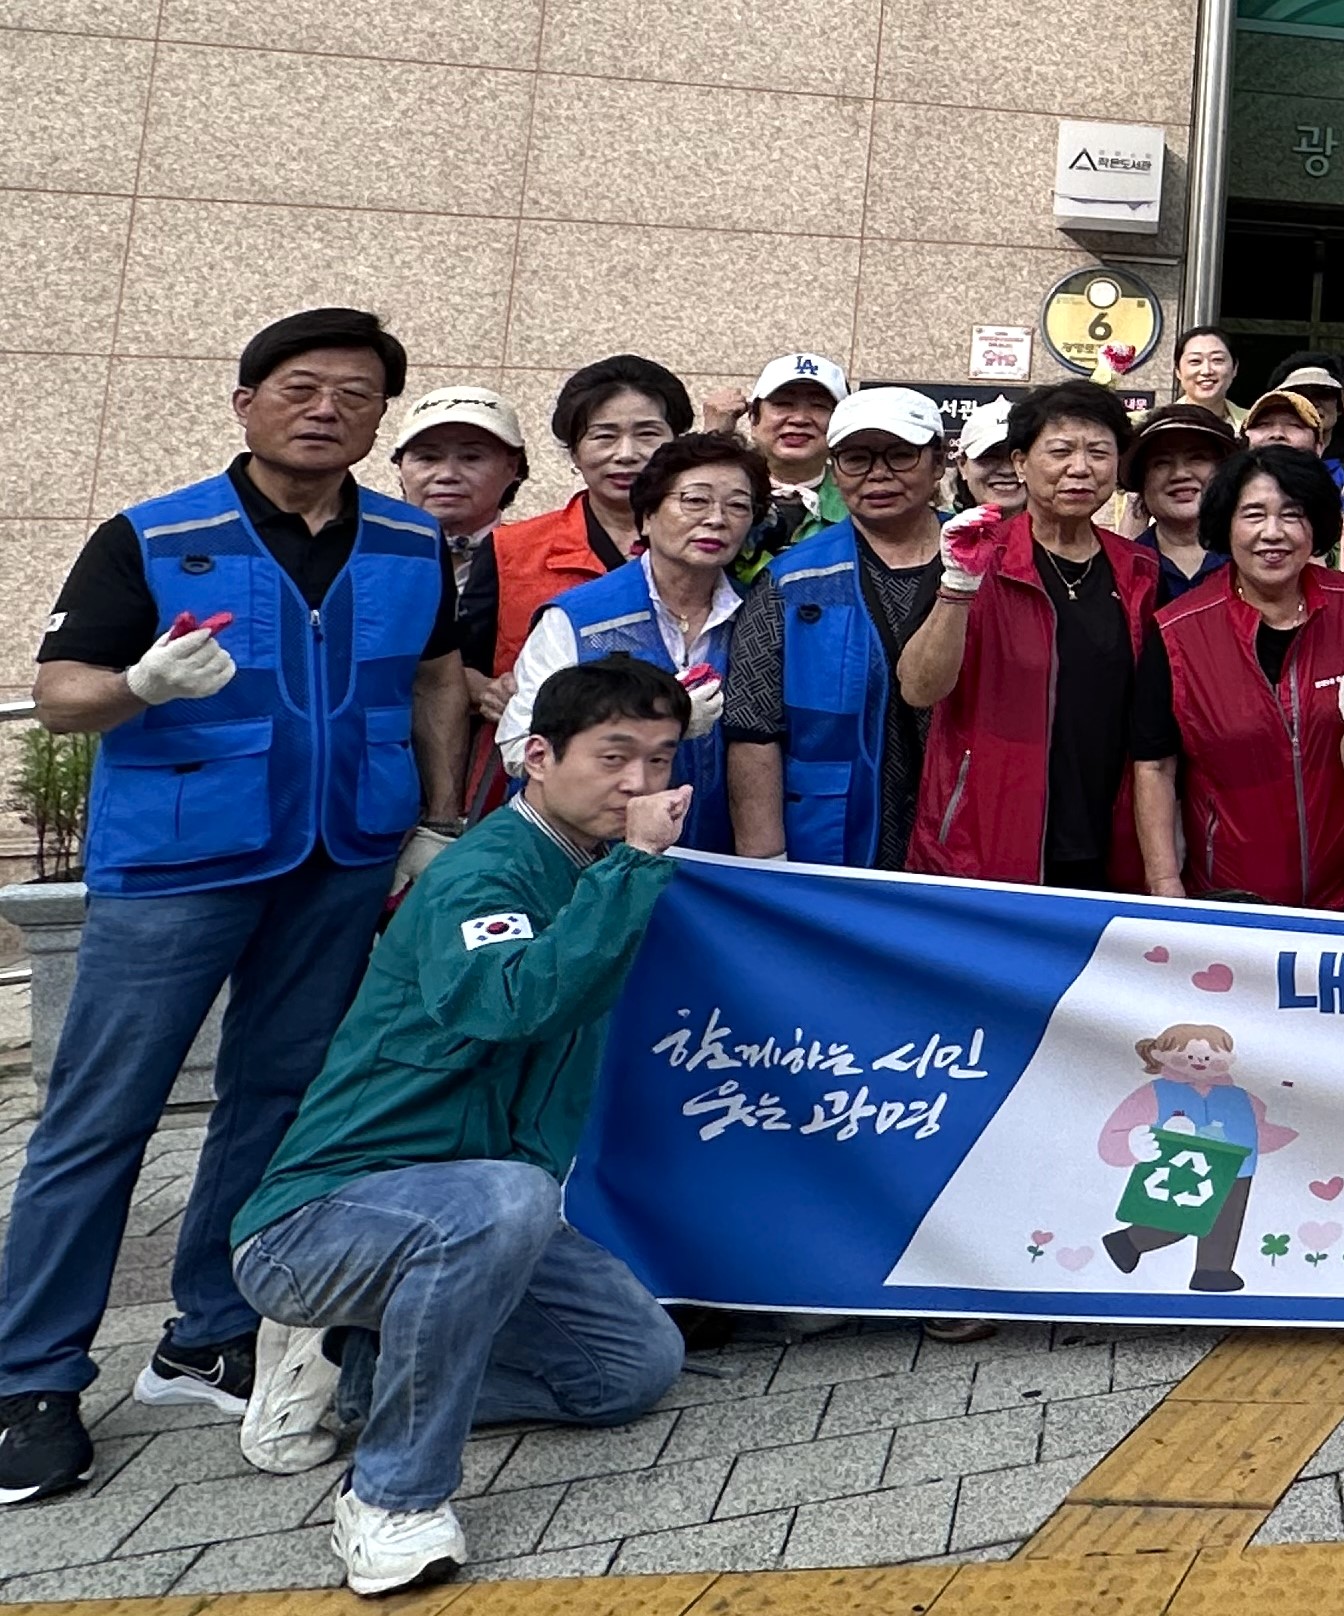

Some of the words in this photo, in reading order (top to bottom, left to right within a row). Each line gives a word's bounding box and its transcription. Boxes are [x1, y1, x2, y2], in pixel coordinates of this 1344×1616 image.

[1088, 312, 1113, 341] 6
[794, 355, 819, 376] LA
[939, 399, 979, 421] 서관
[652, 1006, 865, 1076] 함께하는
[872, 1028, 989, 1080] 시민
[682, 1080, 792, 1141] 웃는
[799, 1085, 949, 1142] 광명
